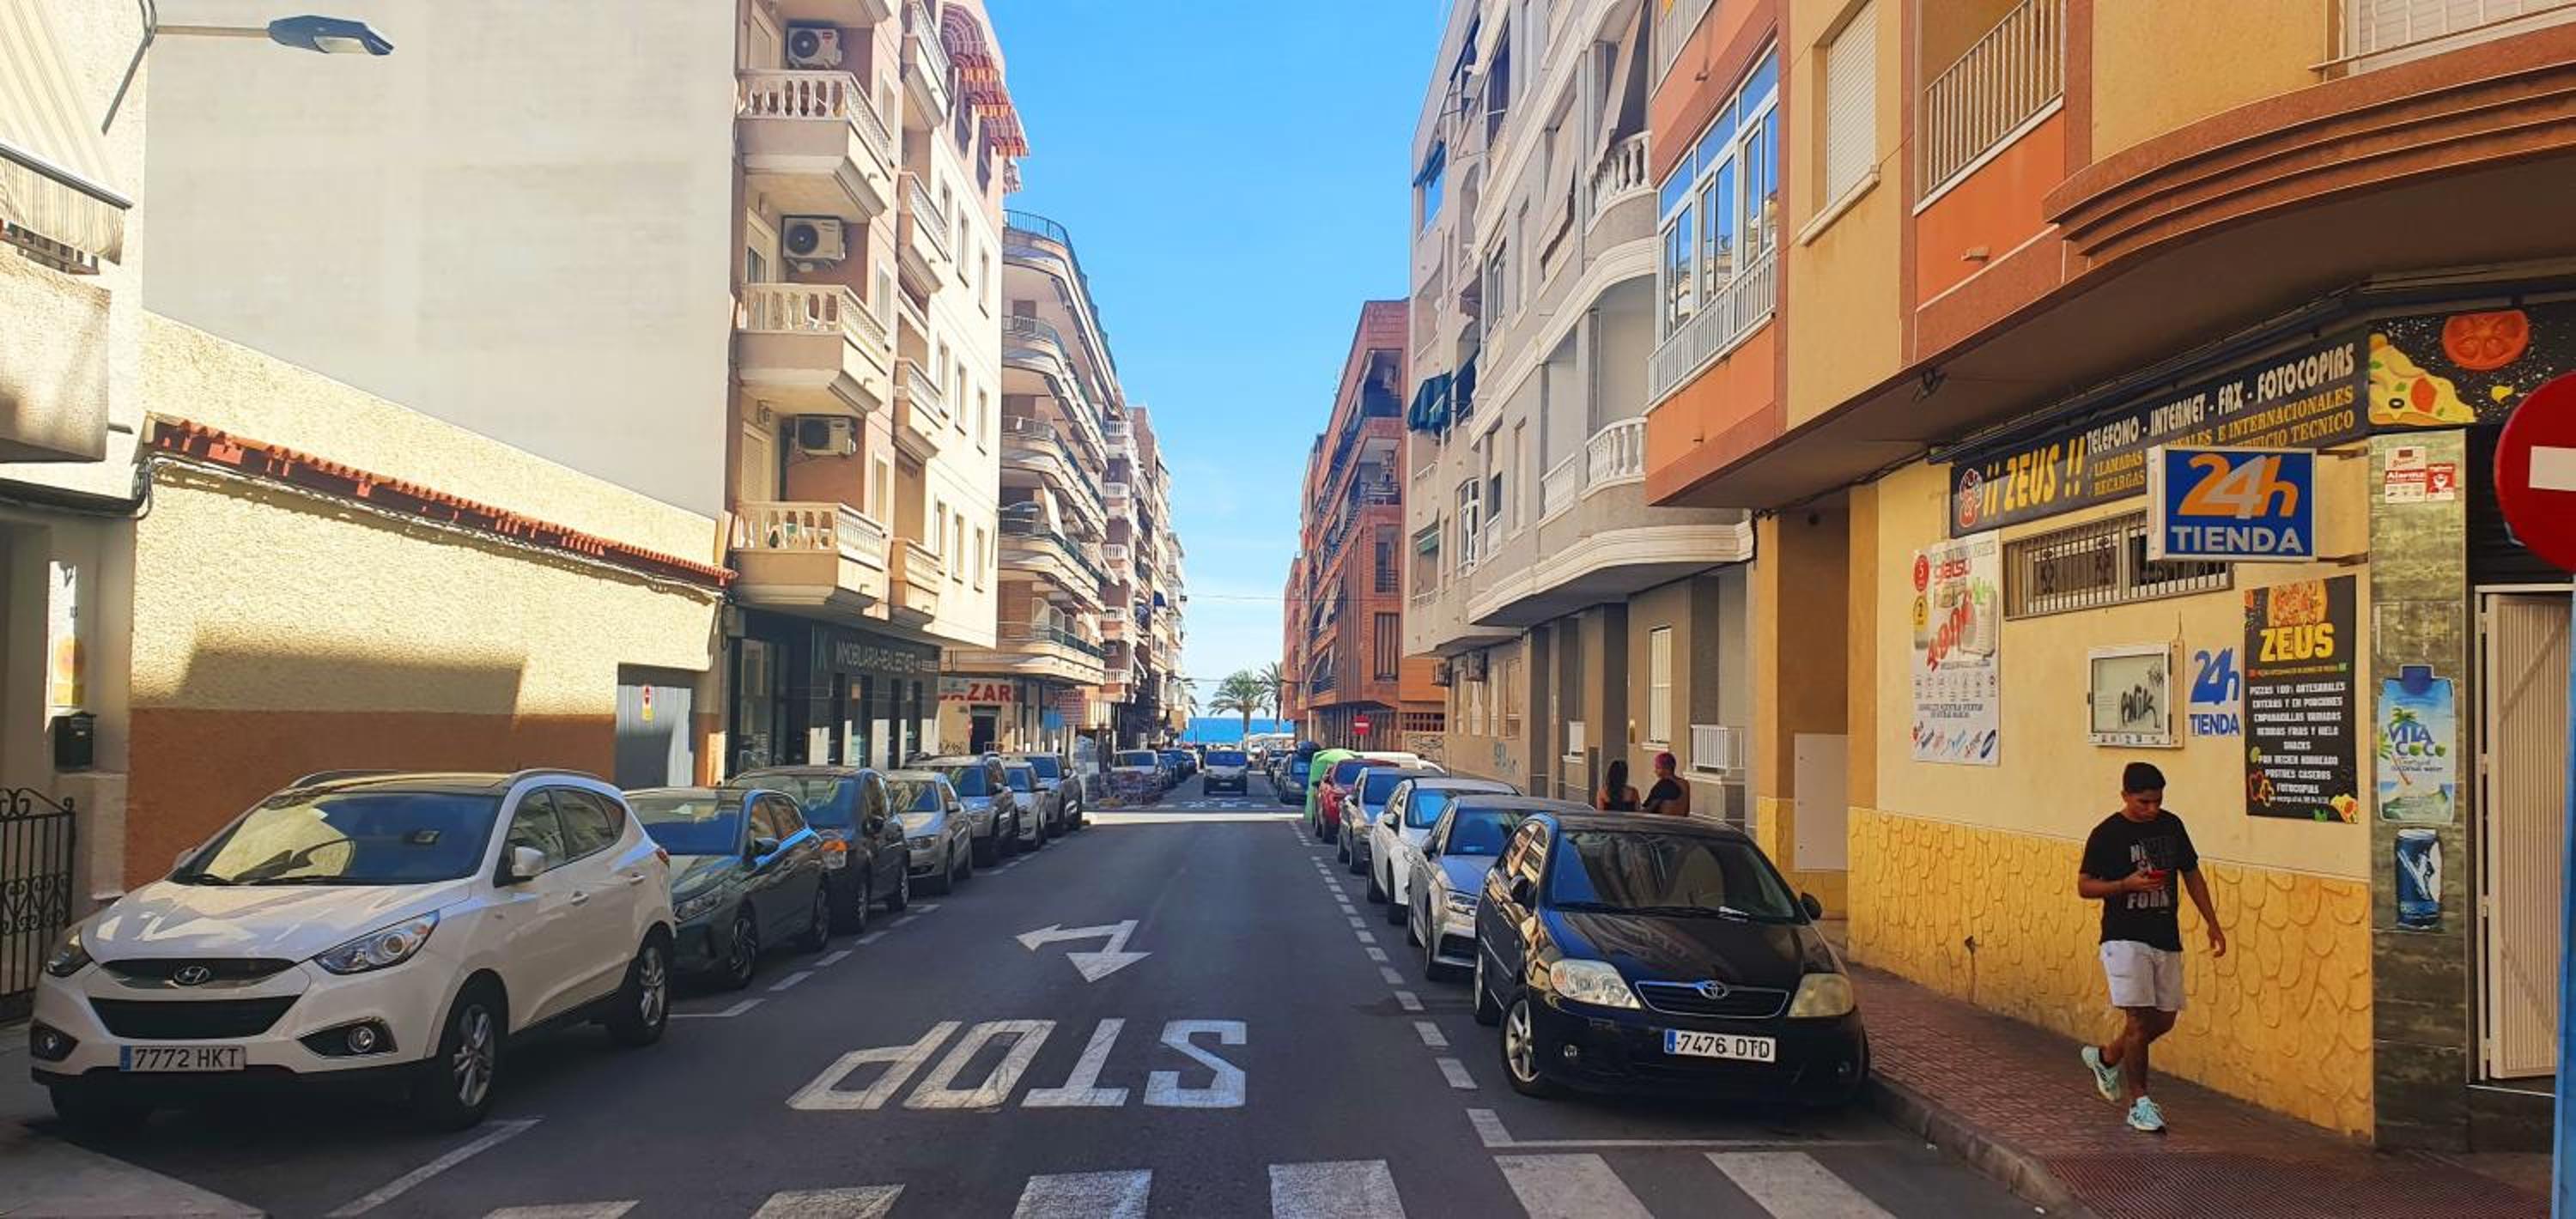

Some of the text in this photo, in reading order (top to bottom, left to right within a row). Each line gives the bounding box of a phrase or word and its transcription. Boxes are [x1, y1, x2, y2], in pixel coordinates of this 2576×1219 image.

[2086, 415, 2139, 456] TELEFONO
[2150, 392, 2206, 437] INTERNET
[2218, 381, 2244, 415] FAX
[2257, 343, 2354, 403] FOTOCOPIAS
[2228, 385, 2354, 438] INTERNACIONALES
[2291, 409, 2354, 442] TECNICO
[2003, 443, 2061, 512] ZEUS
[2177, 453, 2299, 519] 24h
[2171, 526, 2305, 553] TIENDA
[2259, 622, 2335, 662] ZEUS
[2190, 647, 2240, 705] 24h
[2189, 713, 2240, 736] TIENDA
[134, 1047, 240, 1070] 7772 HKT
[785, 1018, 1247, 1110] STOP
[1680, 1033, 1771, 1058] 7476 DTD
